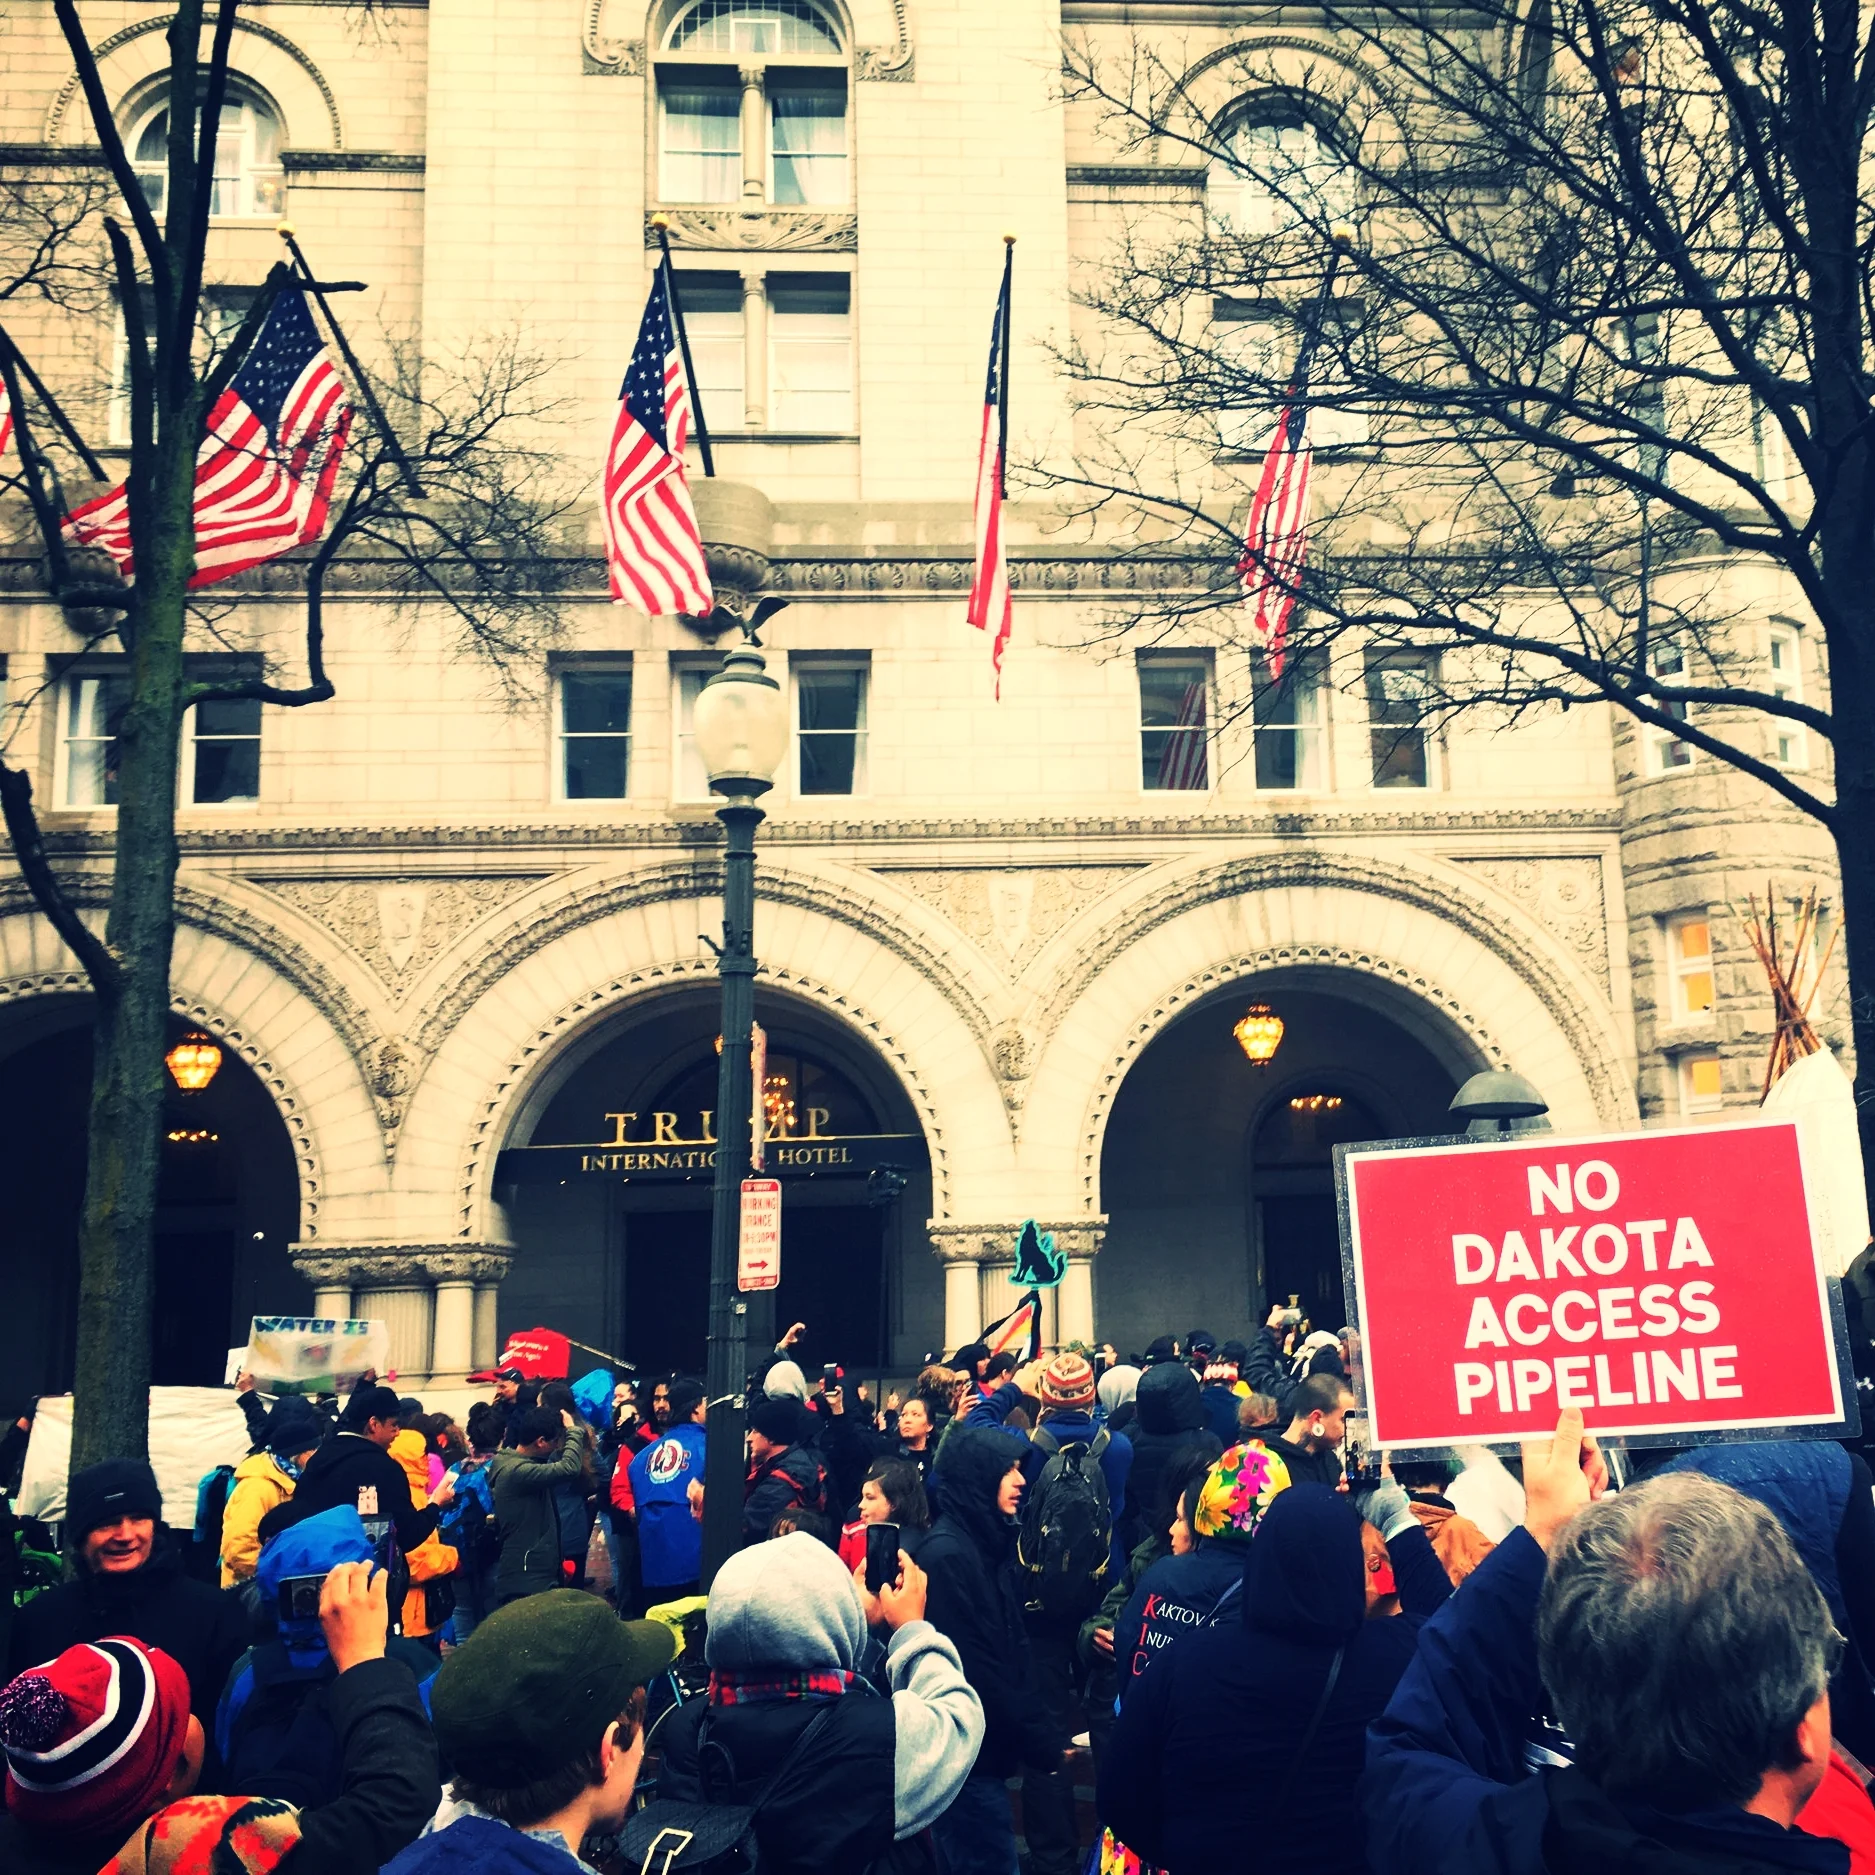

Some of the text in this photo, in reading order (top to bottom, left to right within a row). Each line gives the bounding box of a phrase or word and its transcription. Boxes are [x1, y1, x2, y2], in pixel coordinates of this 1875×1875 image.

[581, 1148, 853, 1171] INTERNATIO HOTEL
[1526, 1159, 1620, 1216] NO
[1451, 1216, 1715, 1285] DAKOTA
[254, 1318, 369, 1335] WATER IS
[1464, 1280, 1721, 1349] ACCESS
[1453, 1344, 1743, 1415] PIPELINE
[1142, 1593, 1220, 1628] KAKTOVK
